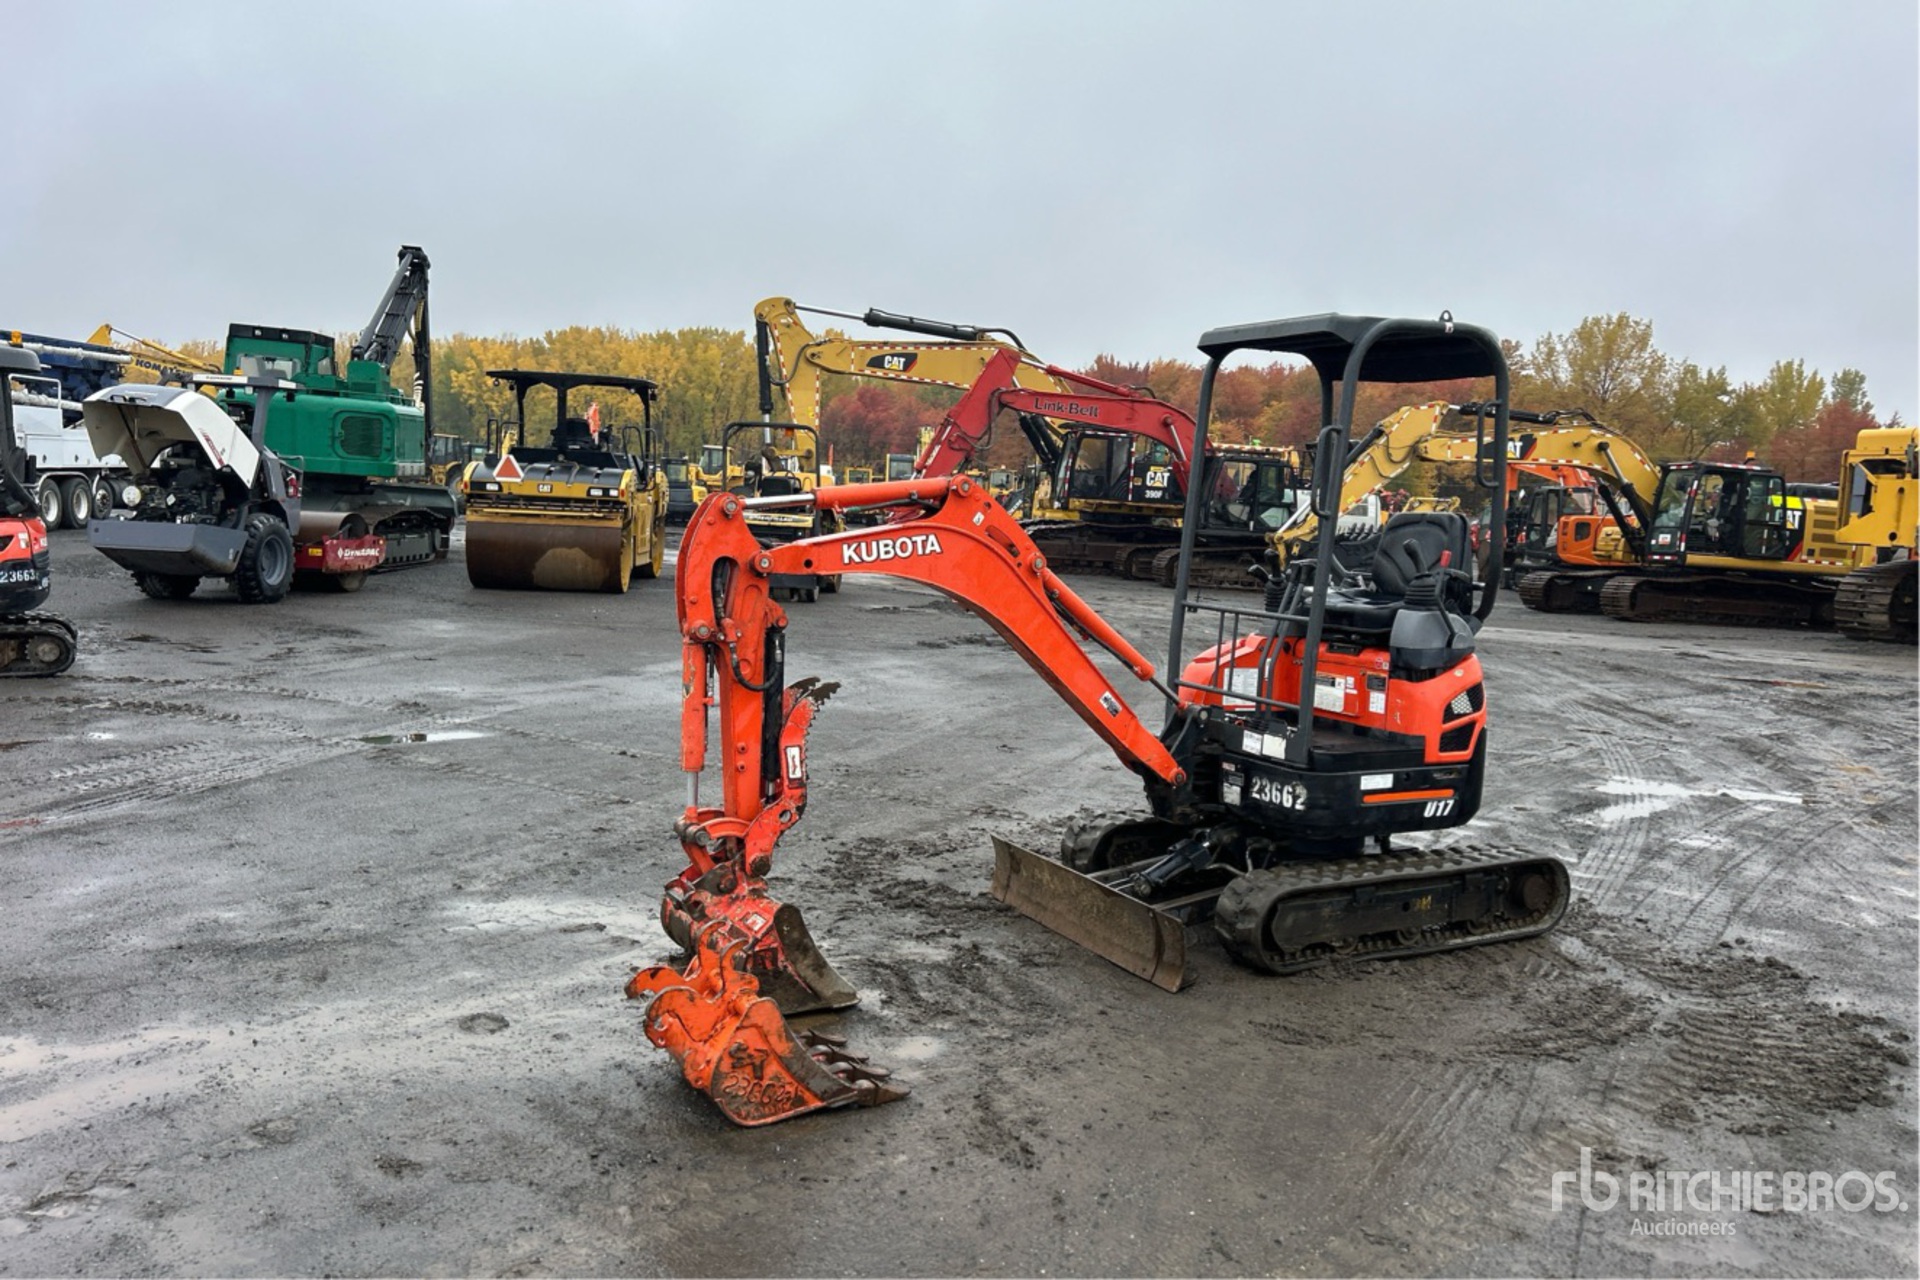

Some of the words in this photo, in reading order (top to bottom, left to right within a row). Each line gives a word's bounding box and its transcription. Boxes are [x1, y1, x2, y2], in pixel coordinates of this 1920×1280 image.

[884, 355, 906, 370] CAT
[1507, 440, 1523, 459] AT
[1146, 471, 1171, 487] CAT
[842, 533, 943, 565] KUBOTA
[1250, 775, 1308, 812] 23662
[1423, 799, 1455, 817] U17
